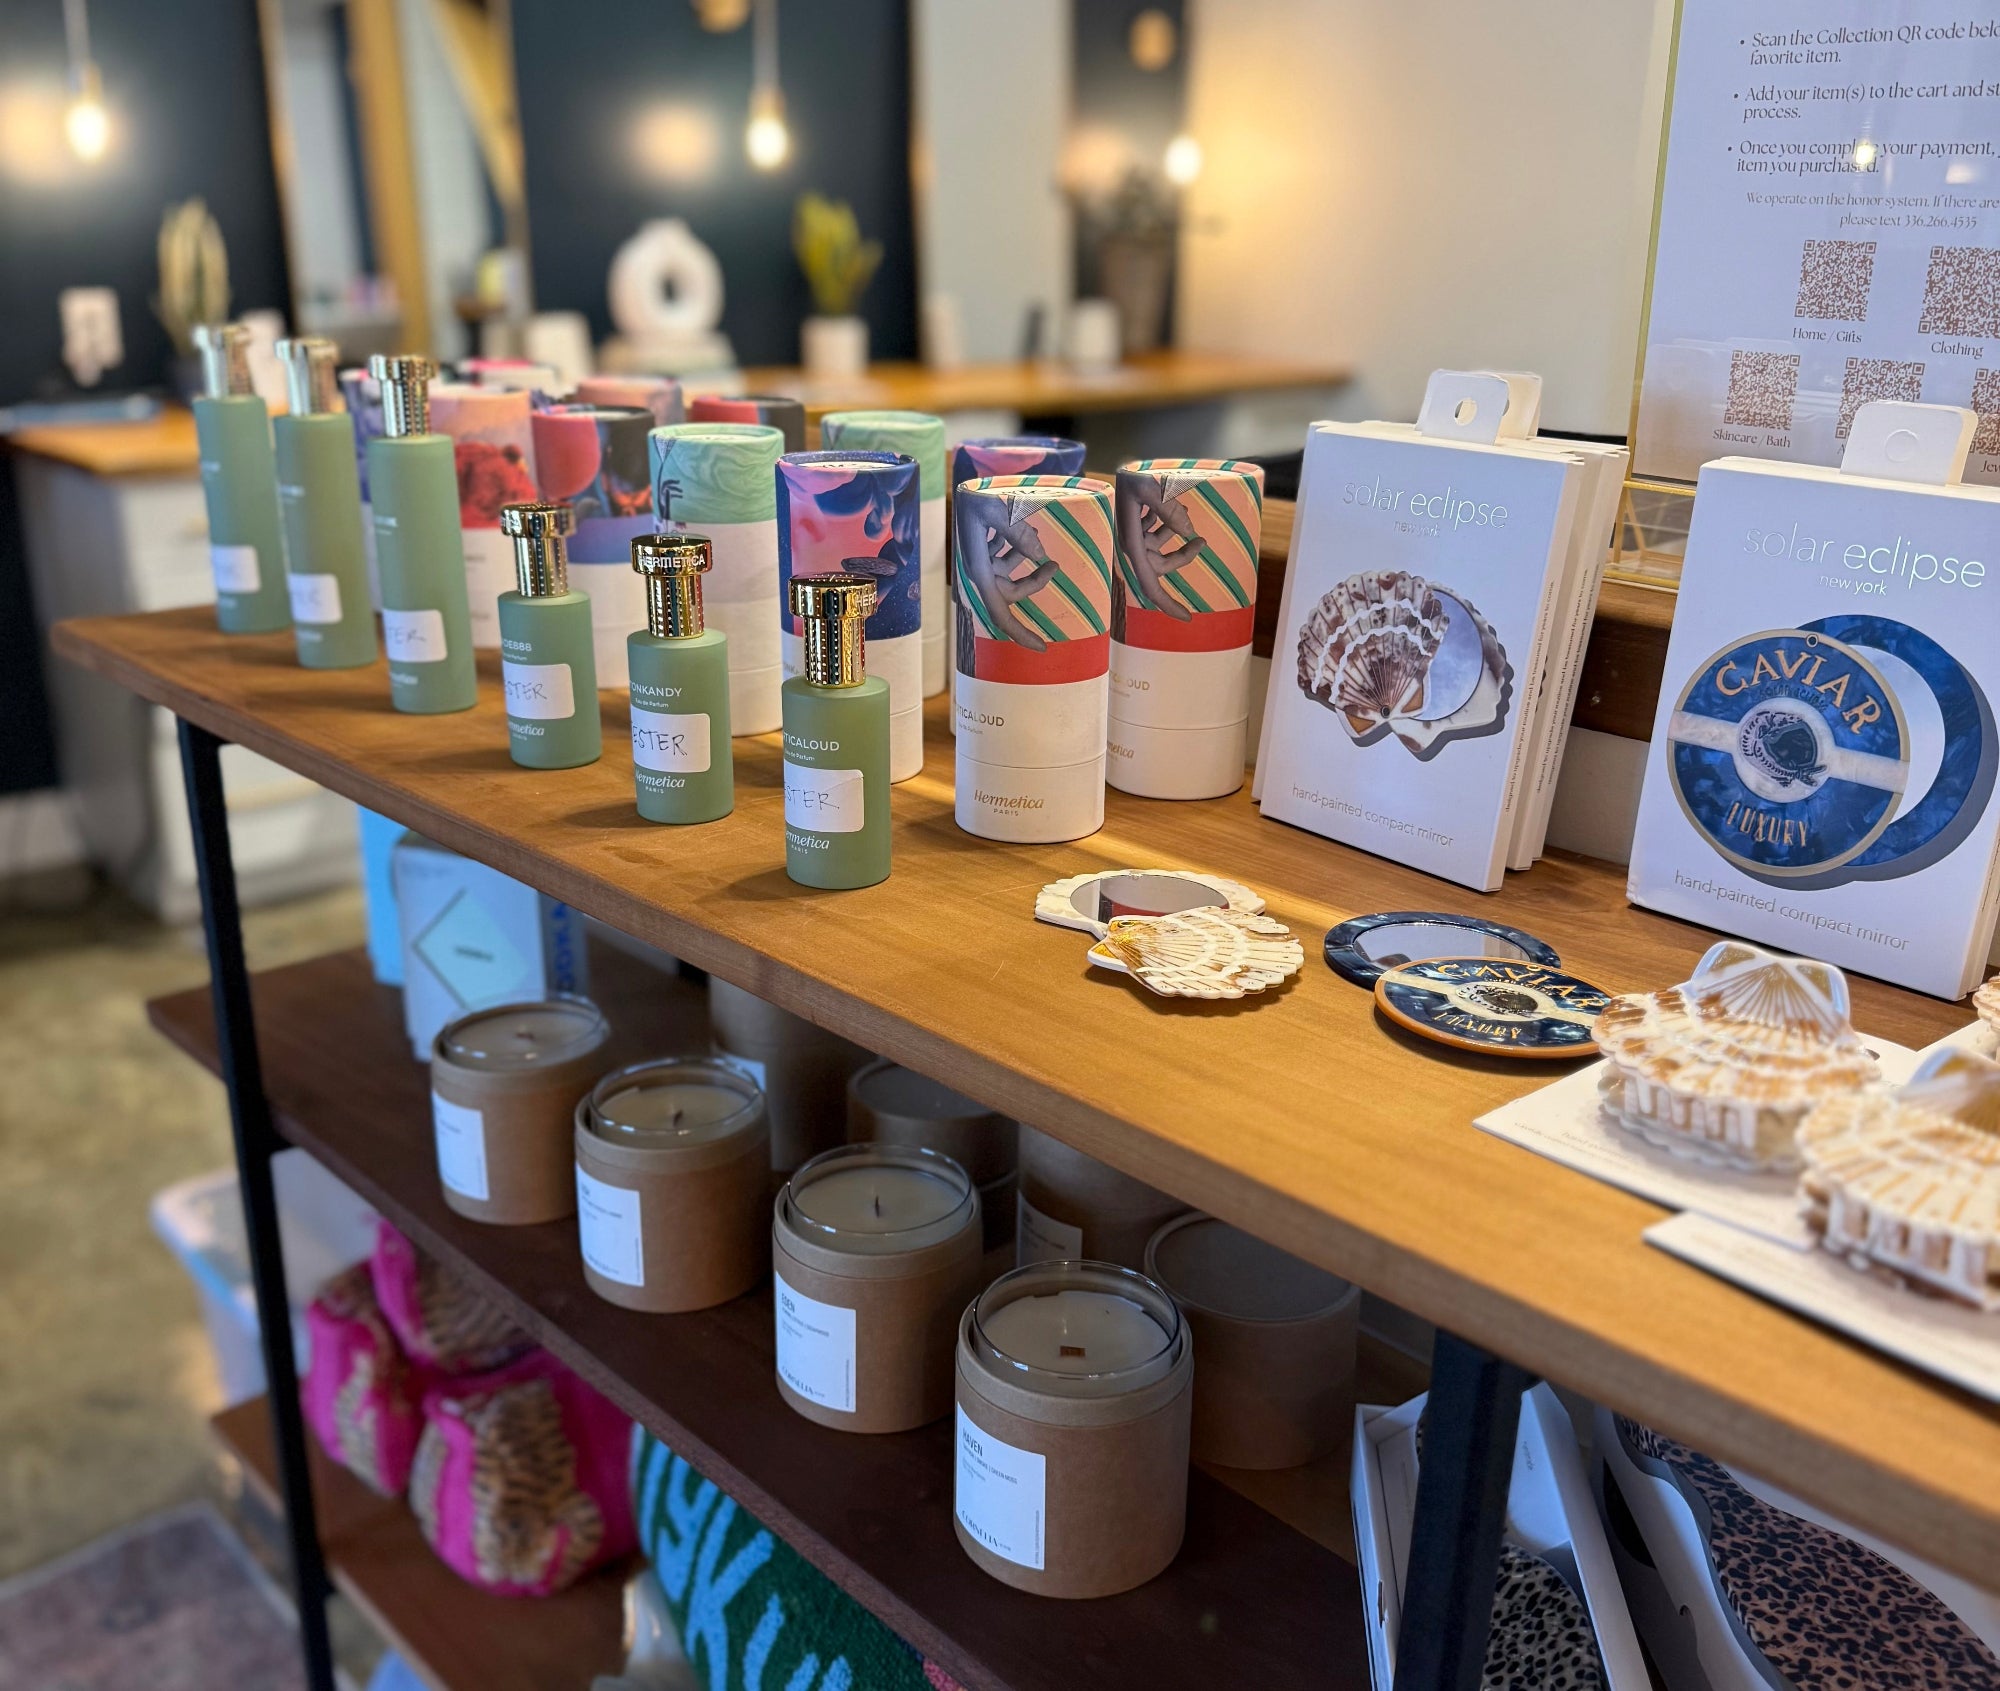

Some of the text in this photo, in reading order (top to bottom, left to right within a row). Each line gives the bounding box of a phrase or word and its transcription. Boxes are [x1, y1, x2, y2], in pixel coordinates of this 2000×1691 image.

[1752, 20, 2000, 47] Scan the Collection QR code belo
[1750, 49, 1841, 65] favorite item.
[1745, 80, 2000, 103] Add your item(s) to the cart and st
[1743, 106, 1801, 123] process.
[1740, 140, 1777, 154] Once
[1777, 143, 1806, 157] you
[1880, 142, 1917, 157] your
[1920, 141, 1995, 159] payment,
[1737, 158, 1768, 172] item
[1769, 160, 1797, 175] you
[1746, 192, 2000, 209] We operate on the honor system. If there are
[1840, 212, 1977, 229] please text 336.266.4535
[1792, 327, 1827, 341] Home
[1836, 329, 1862, 343] Gifts
[1931, 341, 1984, 360] Clothing
[1712, 428, 1758, 445] Skincare
[1765, 432, 1791, 448] Bath
[1980, 460, 2000, 473] Jew
[1343, 475, 1509, 530] solar eclipse
[1393, 518, 1416, 535] new
[1743, 522, 1987, 590] solar eclipse
[1819, 573, 1887, 597] new york
[631, 681, 682, 697] ONKANDY
[1715, 650, 1882, 734] CAVIAR
[957, 703, 1005, 727] TICALOUD
[632, 725, 688, 756] ESTER
[784, 732, 840, 751] TICALOUD
[784, 785, 840, 811] STER
[974, 789, 1044, 809] Hermetica
[993, 808, 1019, 816] PARIS
[1291, 782, 1454, 849] hand-painted compact mirror
[1726, 802, 1809, 848] LUXURY
[1673, 867, 1911, 952] hand-painted compact mirror
[1436, 963, 1605, 1009] CAVIAR
[962, 1427, 983, 1457] HAVEN
